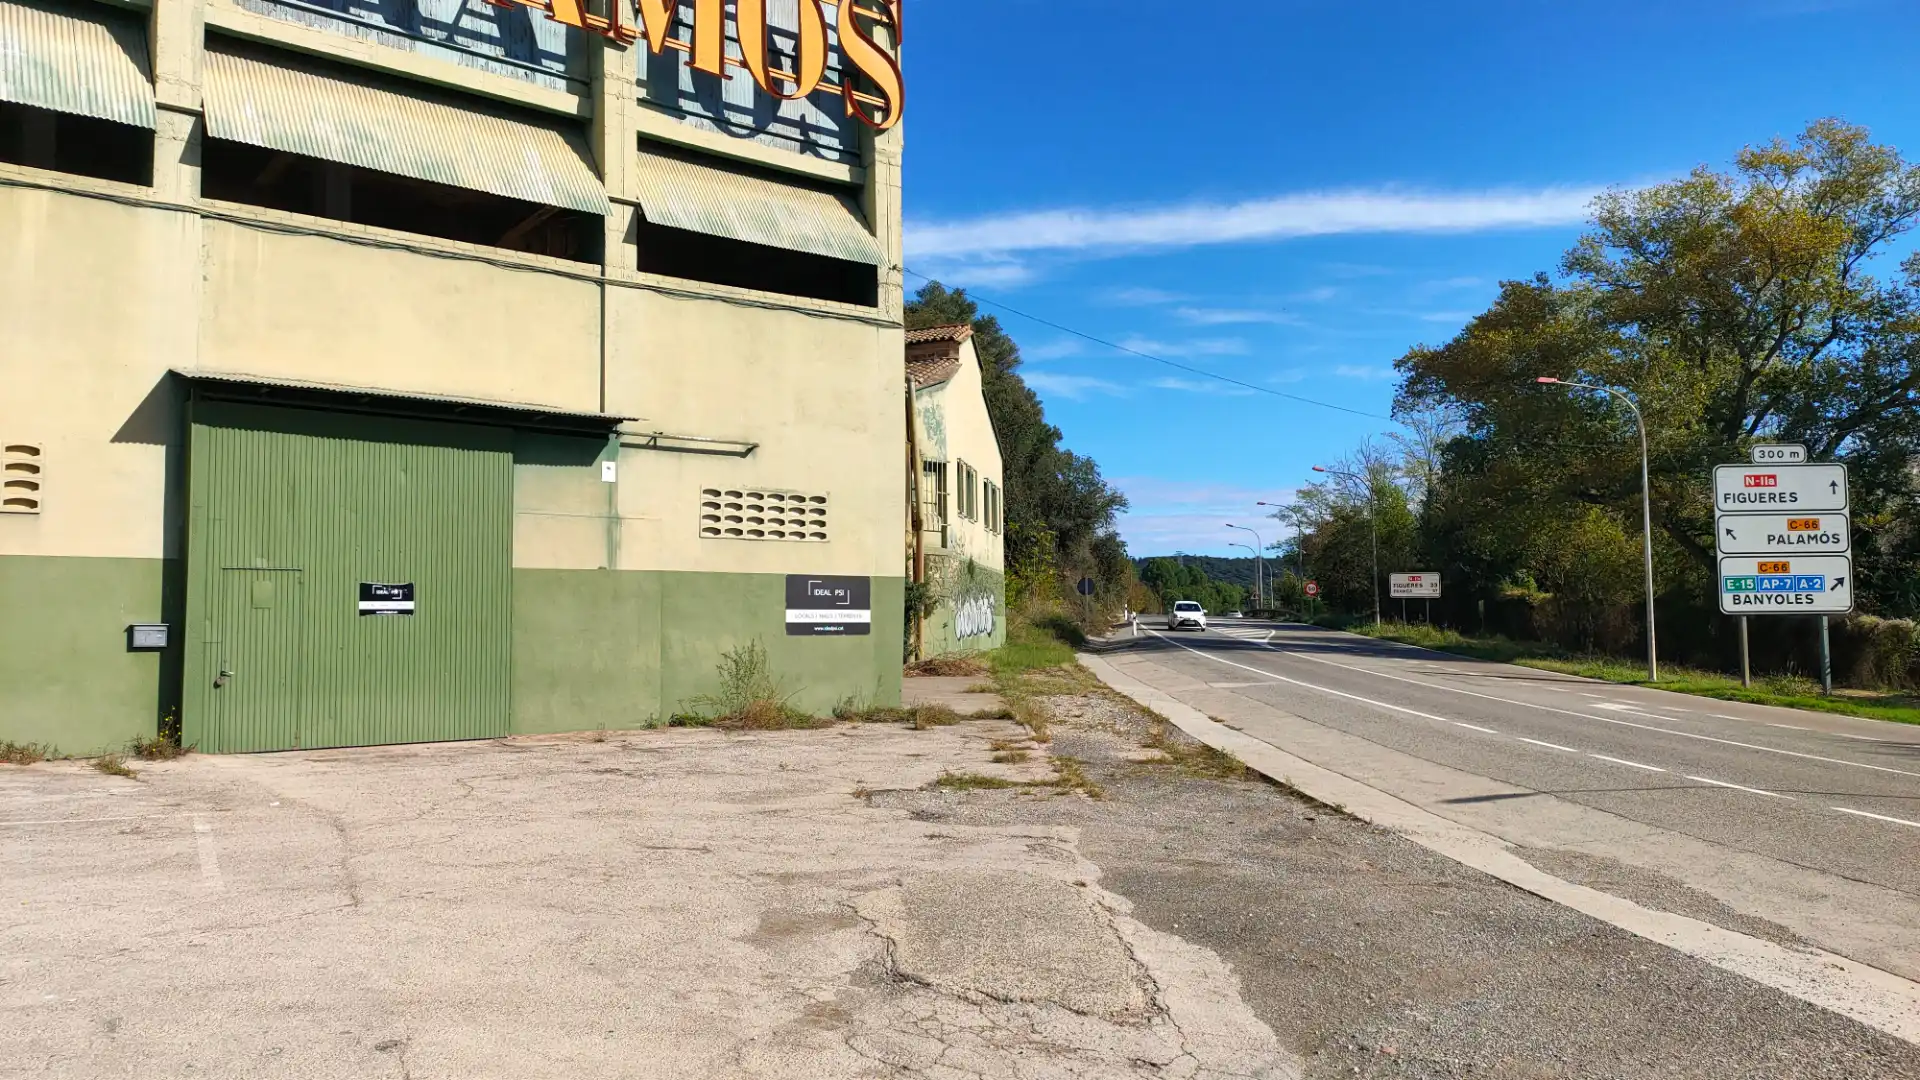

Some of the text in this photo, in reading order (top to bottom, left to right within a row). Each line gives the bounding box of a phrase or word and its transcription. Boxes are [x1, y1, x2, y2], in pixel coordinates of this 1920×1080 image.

[1758, 450, 1800, 459] 300 m
[1723, 492, 1798, 504] FIGUERES
[1790, 520, 1818, 530] C-66
[1767, 531, 1840, 545] PALAMÓS
[1759, 563, 1788, 572] C-66
[1726, 579, 1821, 589] E-15 AP-7 A-2
[1732, 594, 1814, 605] BANYOLES
